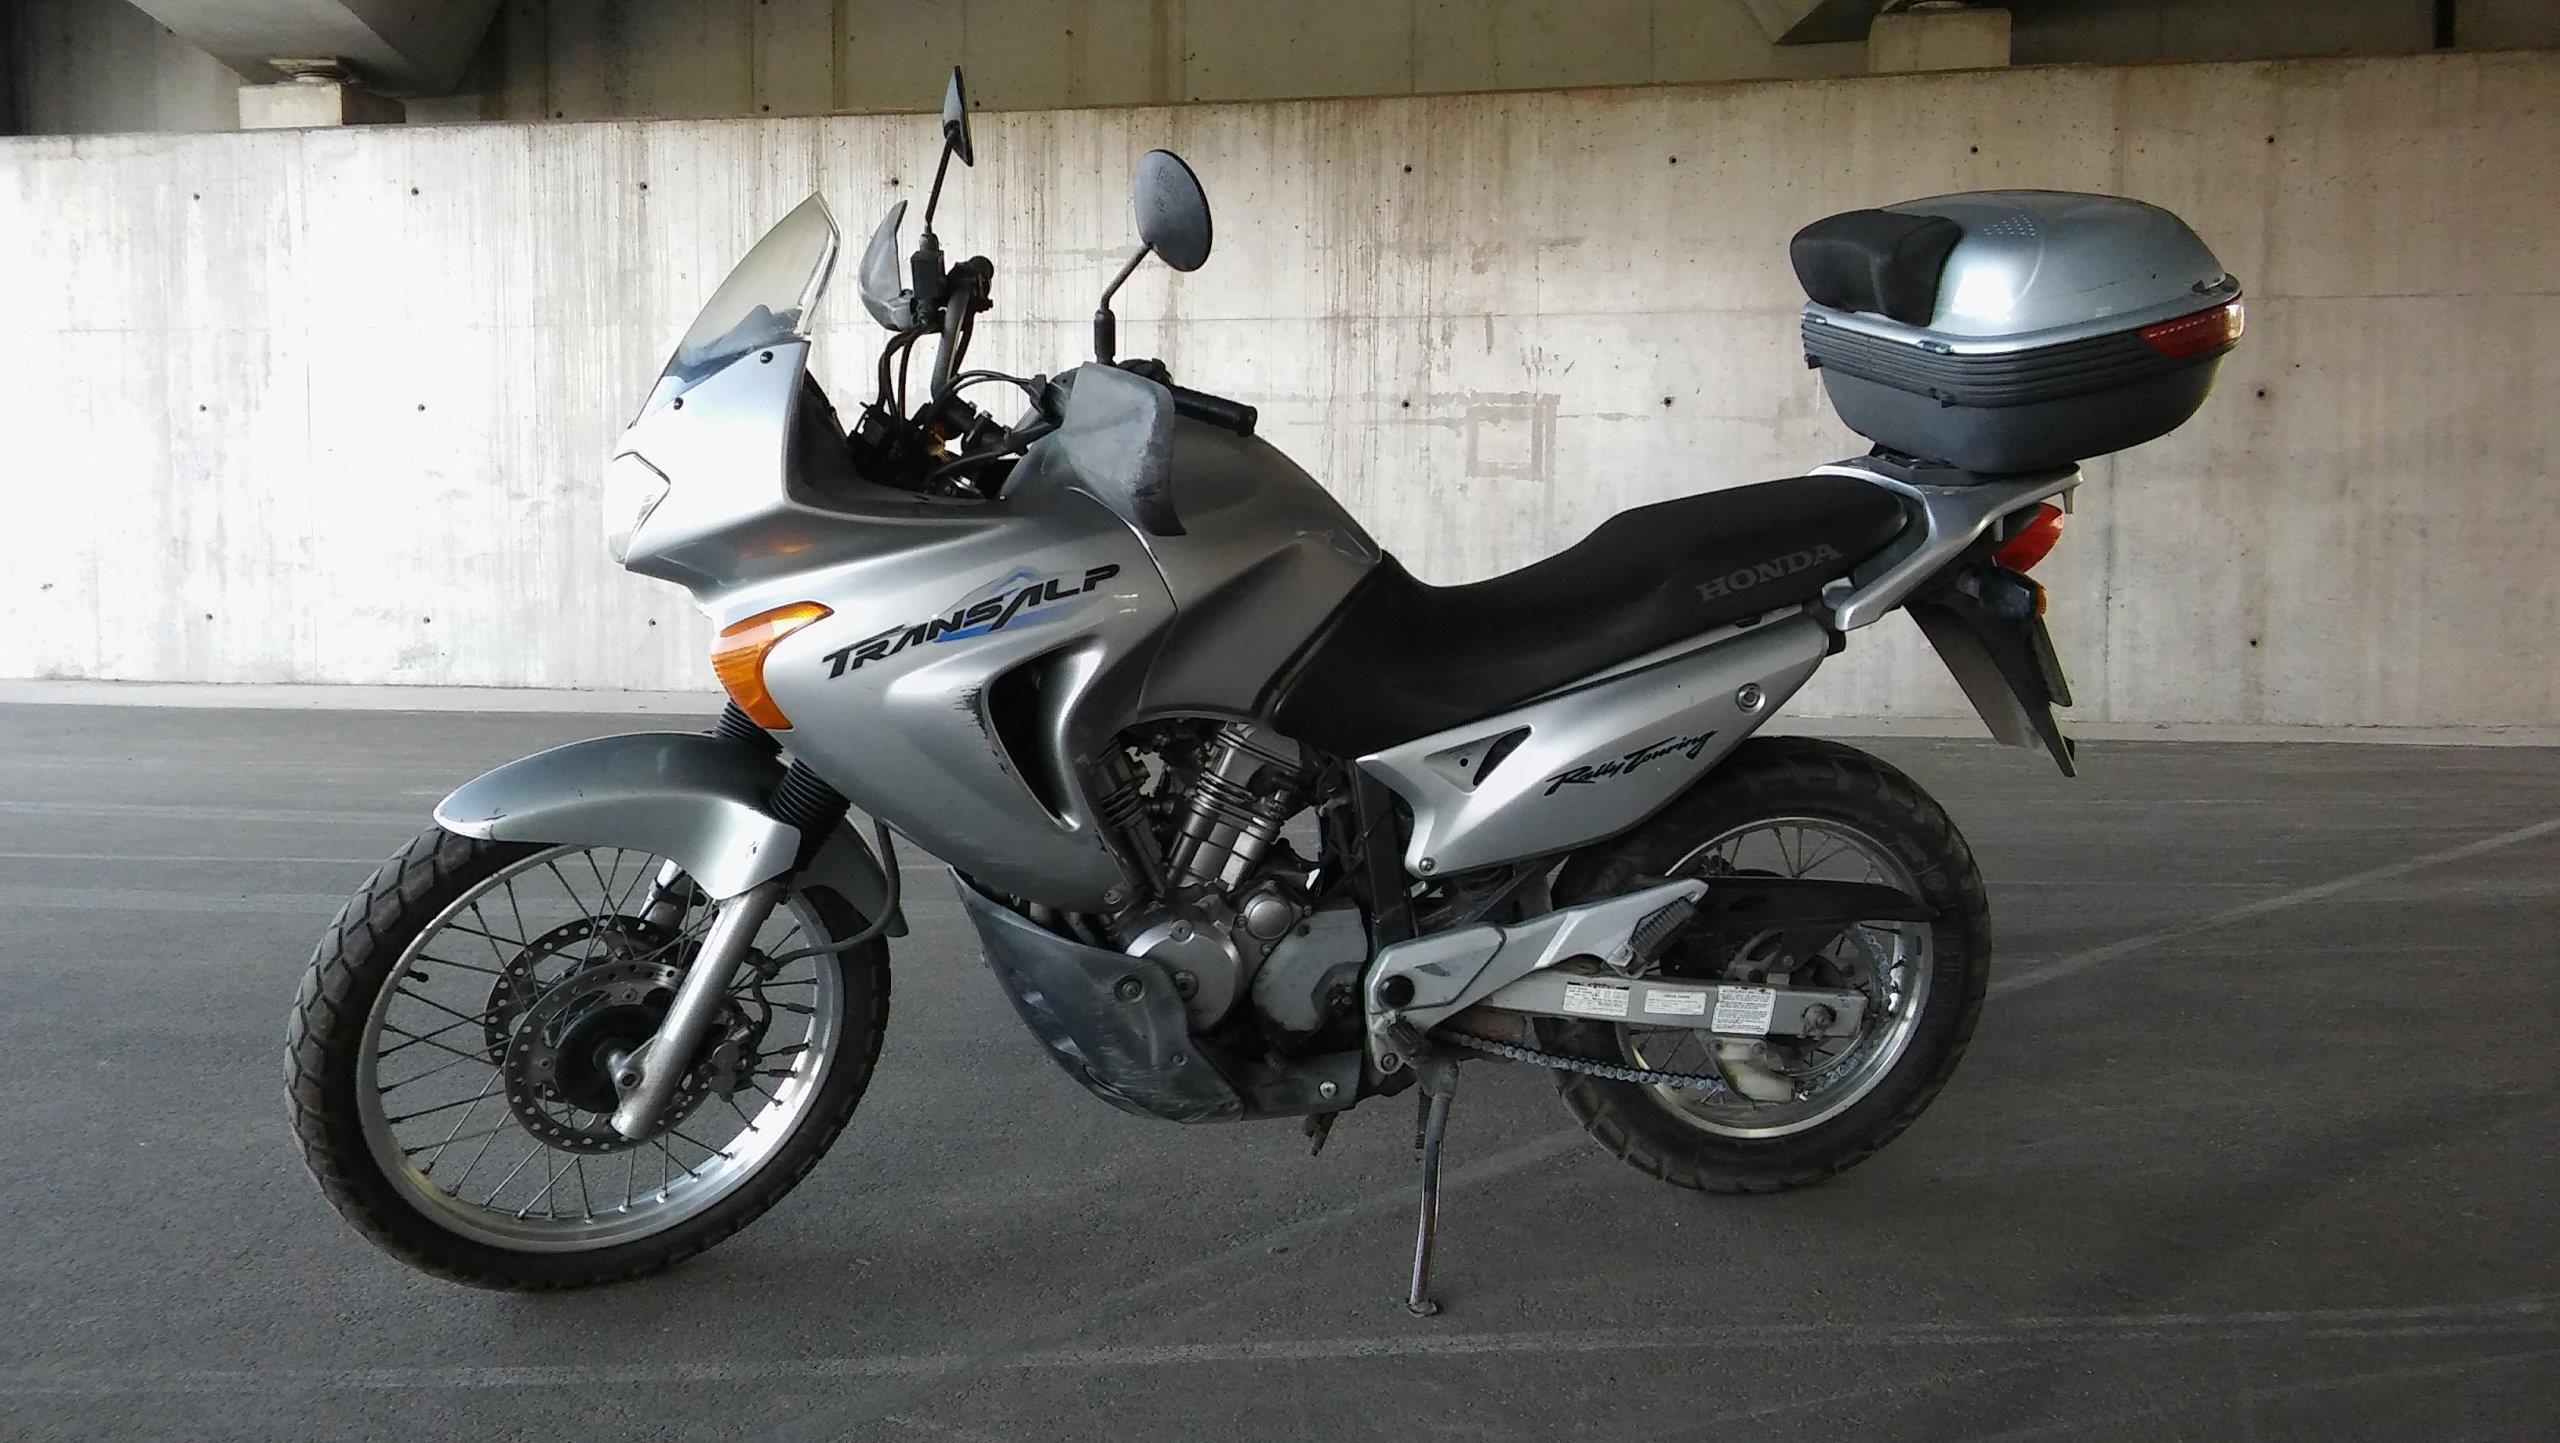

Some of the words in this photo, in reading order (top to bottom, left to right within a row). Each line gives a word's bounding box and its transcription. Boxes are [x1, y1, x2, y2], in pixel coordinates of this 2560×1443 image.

[1695, 543, 1842, 600] HONDA
[822, 563, 1121, 679] TRANSALP
[1544, 760, 1625, 796] Rally
[1623, 730, 1718, 774] Touring
